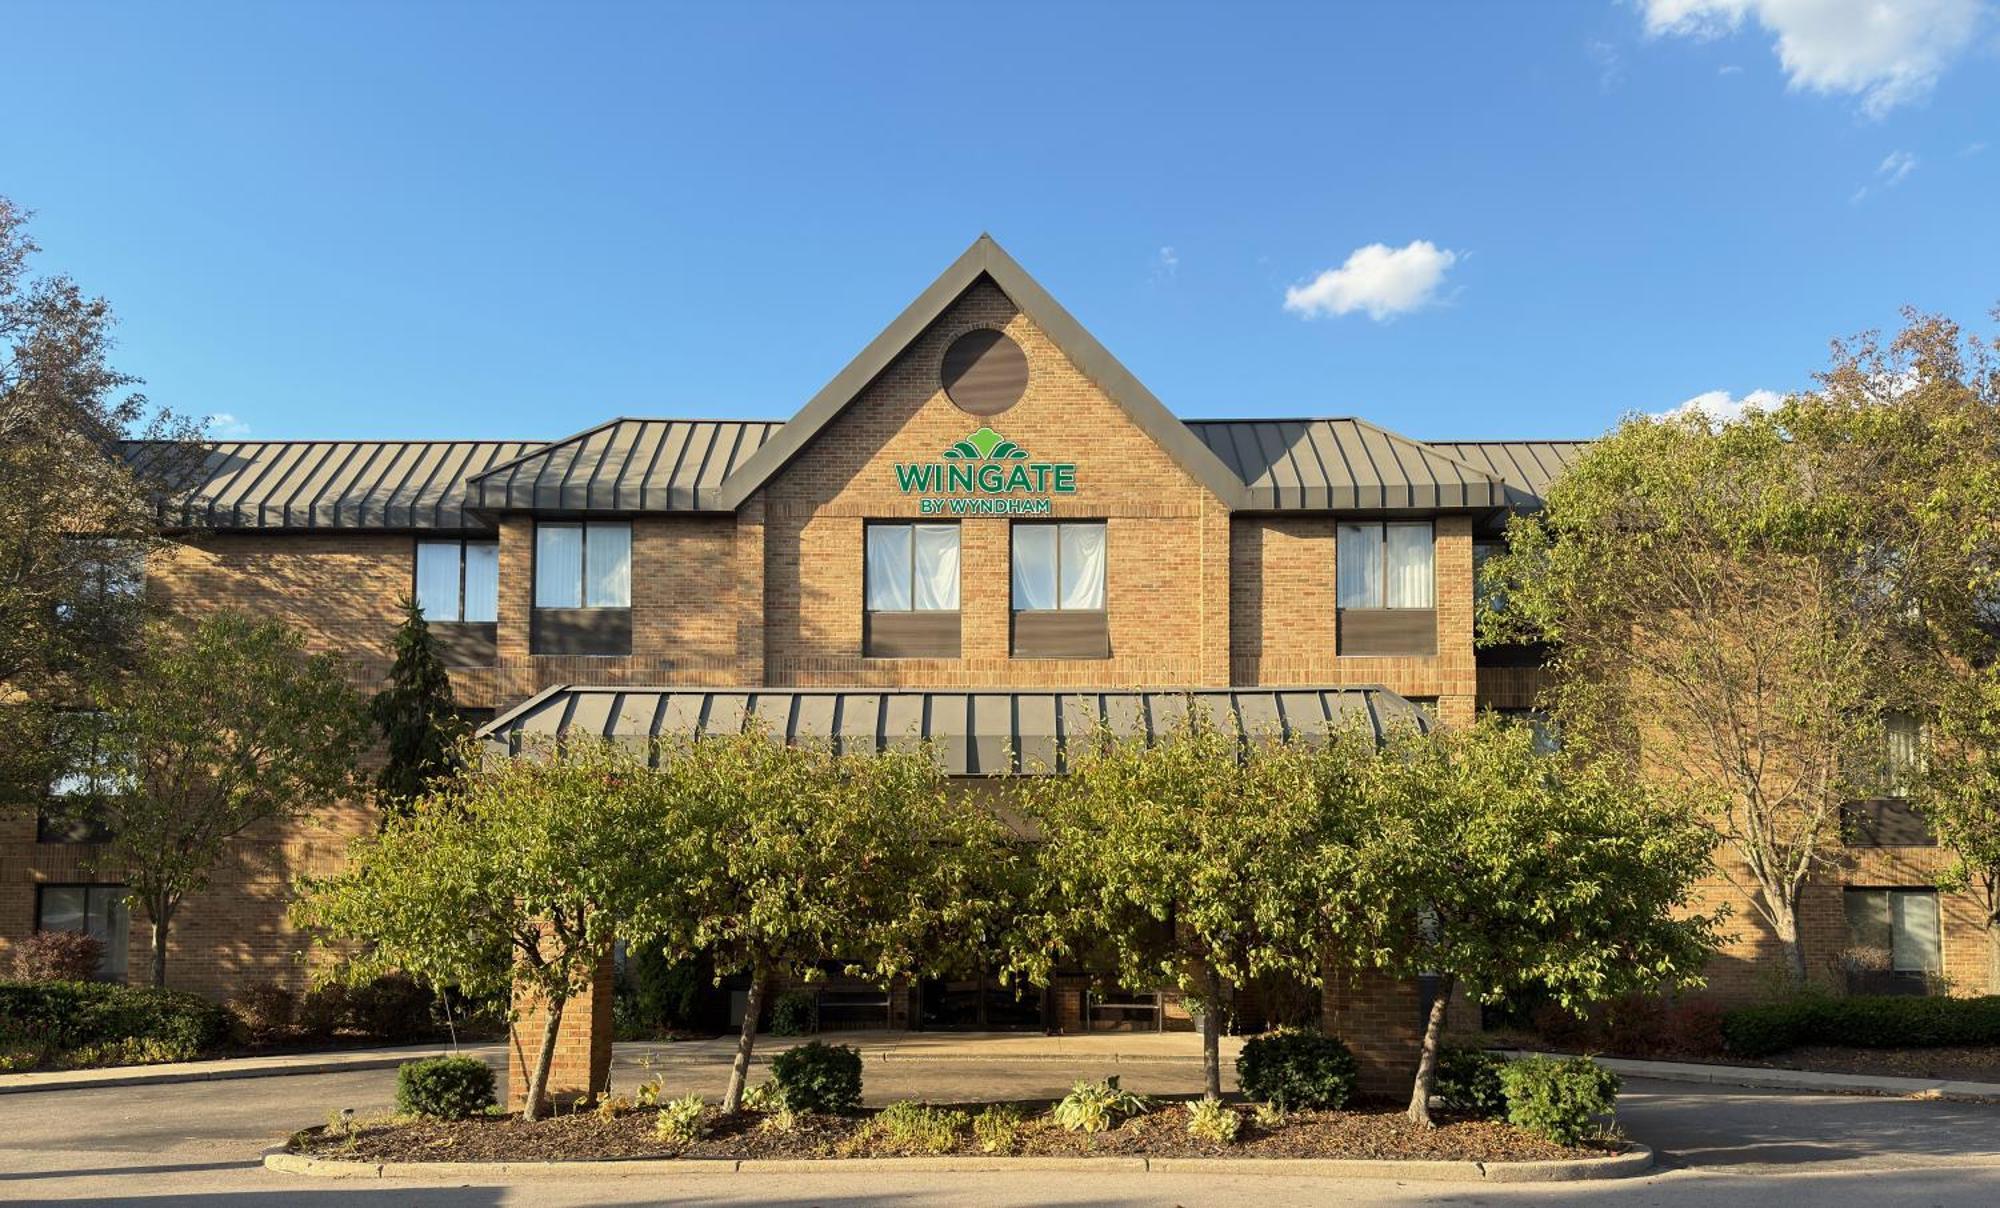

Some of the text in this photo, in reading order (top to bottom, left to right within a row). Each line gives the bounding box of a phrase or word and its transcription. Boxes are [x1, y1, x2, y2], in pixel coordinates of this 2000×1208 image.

[895, 464, 1076, 494] WINGATE
[920, 499, 1050, 513] BY WYNDHAM
